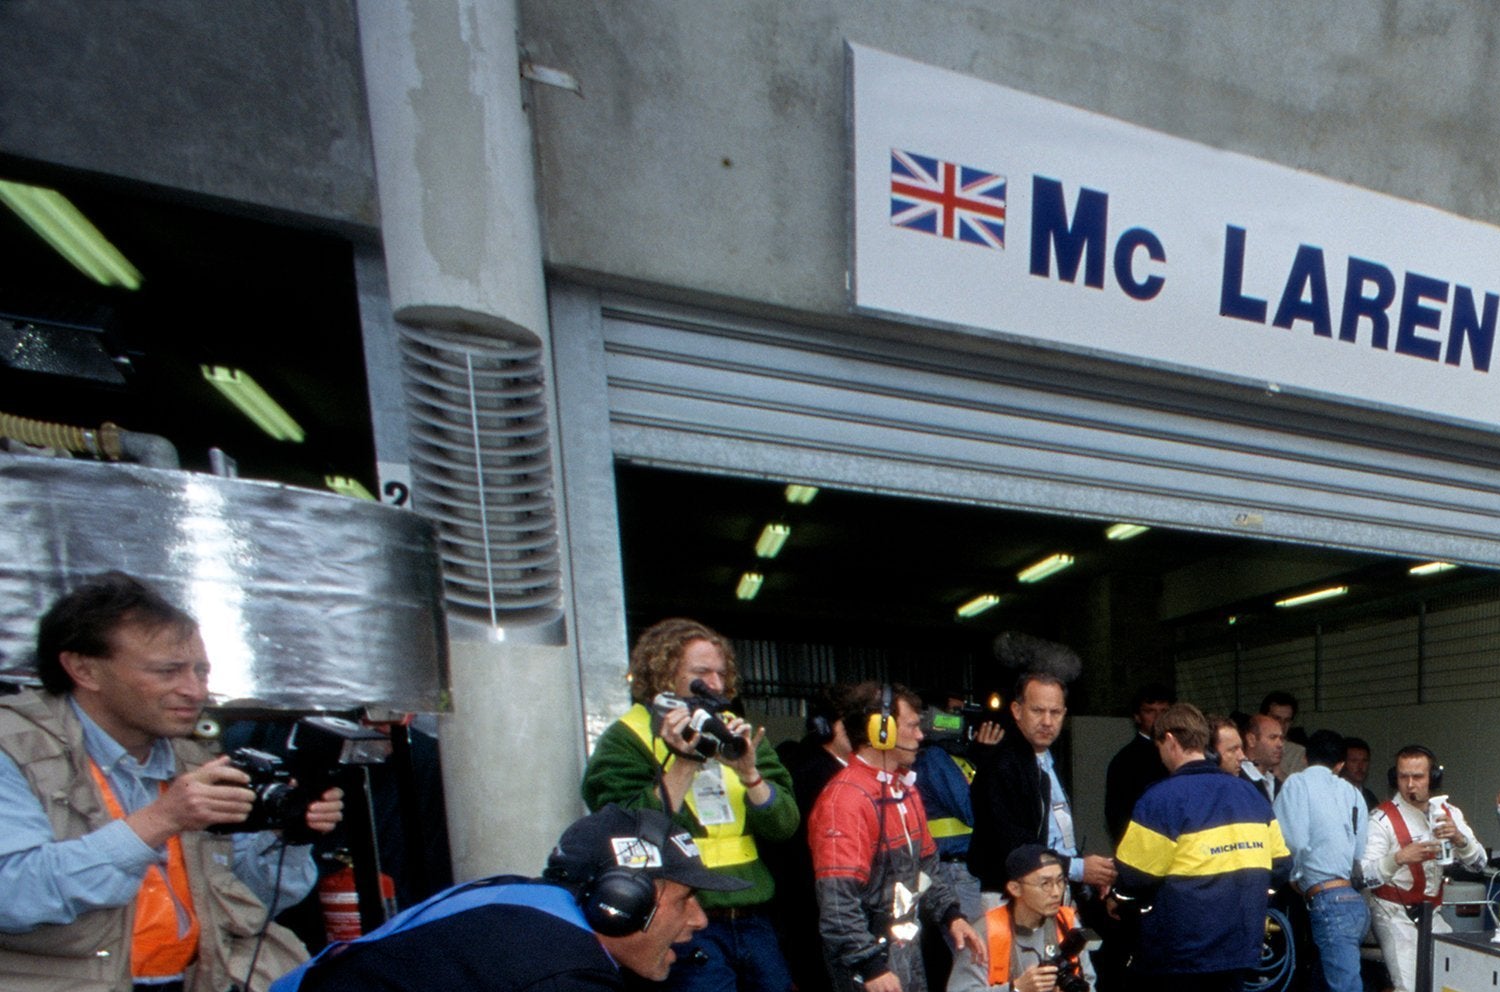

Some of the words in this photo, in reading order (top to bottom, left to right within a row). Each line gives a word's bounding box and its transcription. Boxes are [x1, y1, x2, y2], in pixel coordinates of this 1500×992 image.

[1030, 174, 1166, 301] Mc
[1219, 223, 1500, 373] LAREN
[1210, 841, 1264, 855] MICHELIN
